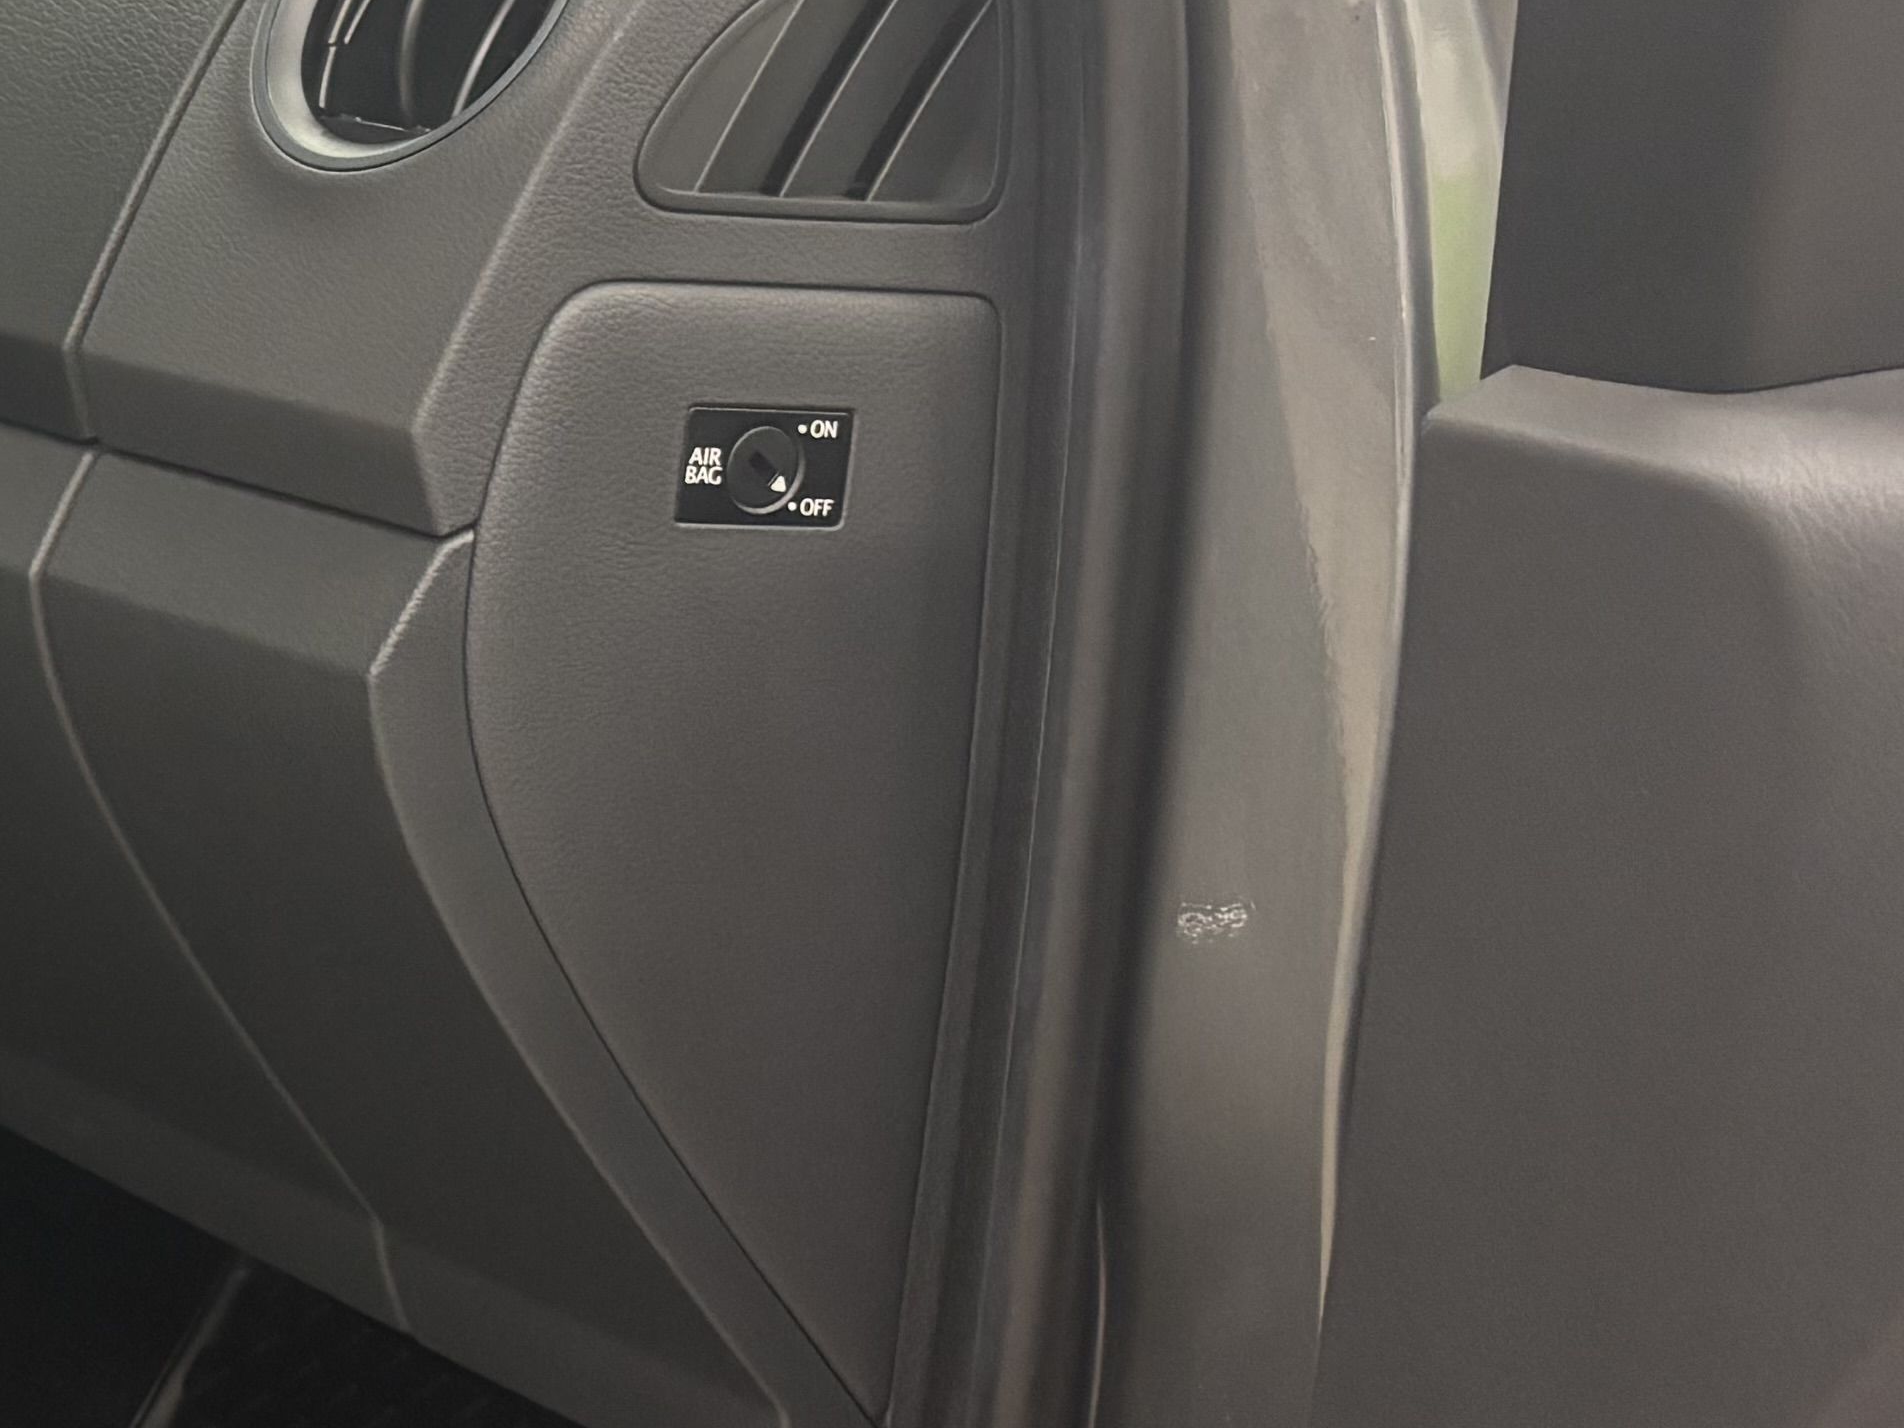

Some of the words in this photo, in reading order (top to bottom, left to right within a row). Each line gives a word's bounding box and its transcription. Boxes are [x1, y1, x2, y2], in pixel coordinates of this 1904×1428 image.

[810, 420, 838, 439] ON
[688, 447, 721, 466] AIR
[684, 466, 723, 485] BAG
[799, 498, 835, 516] OFF
